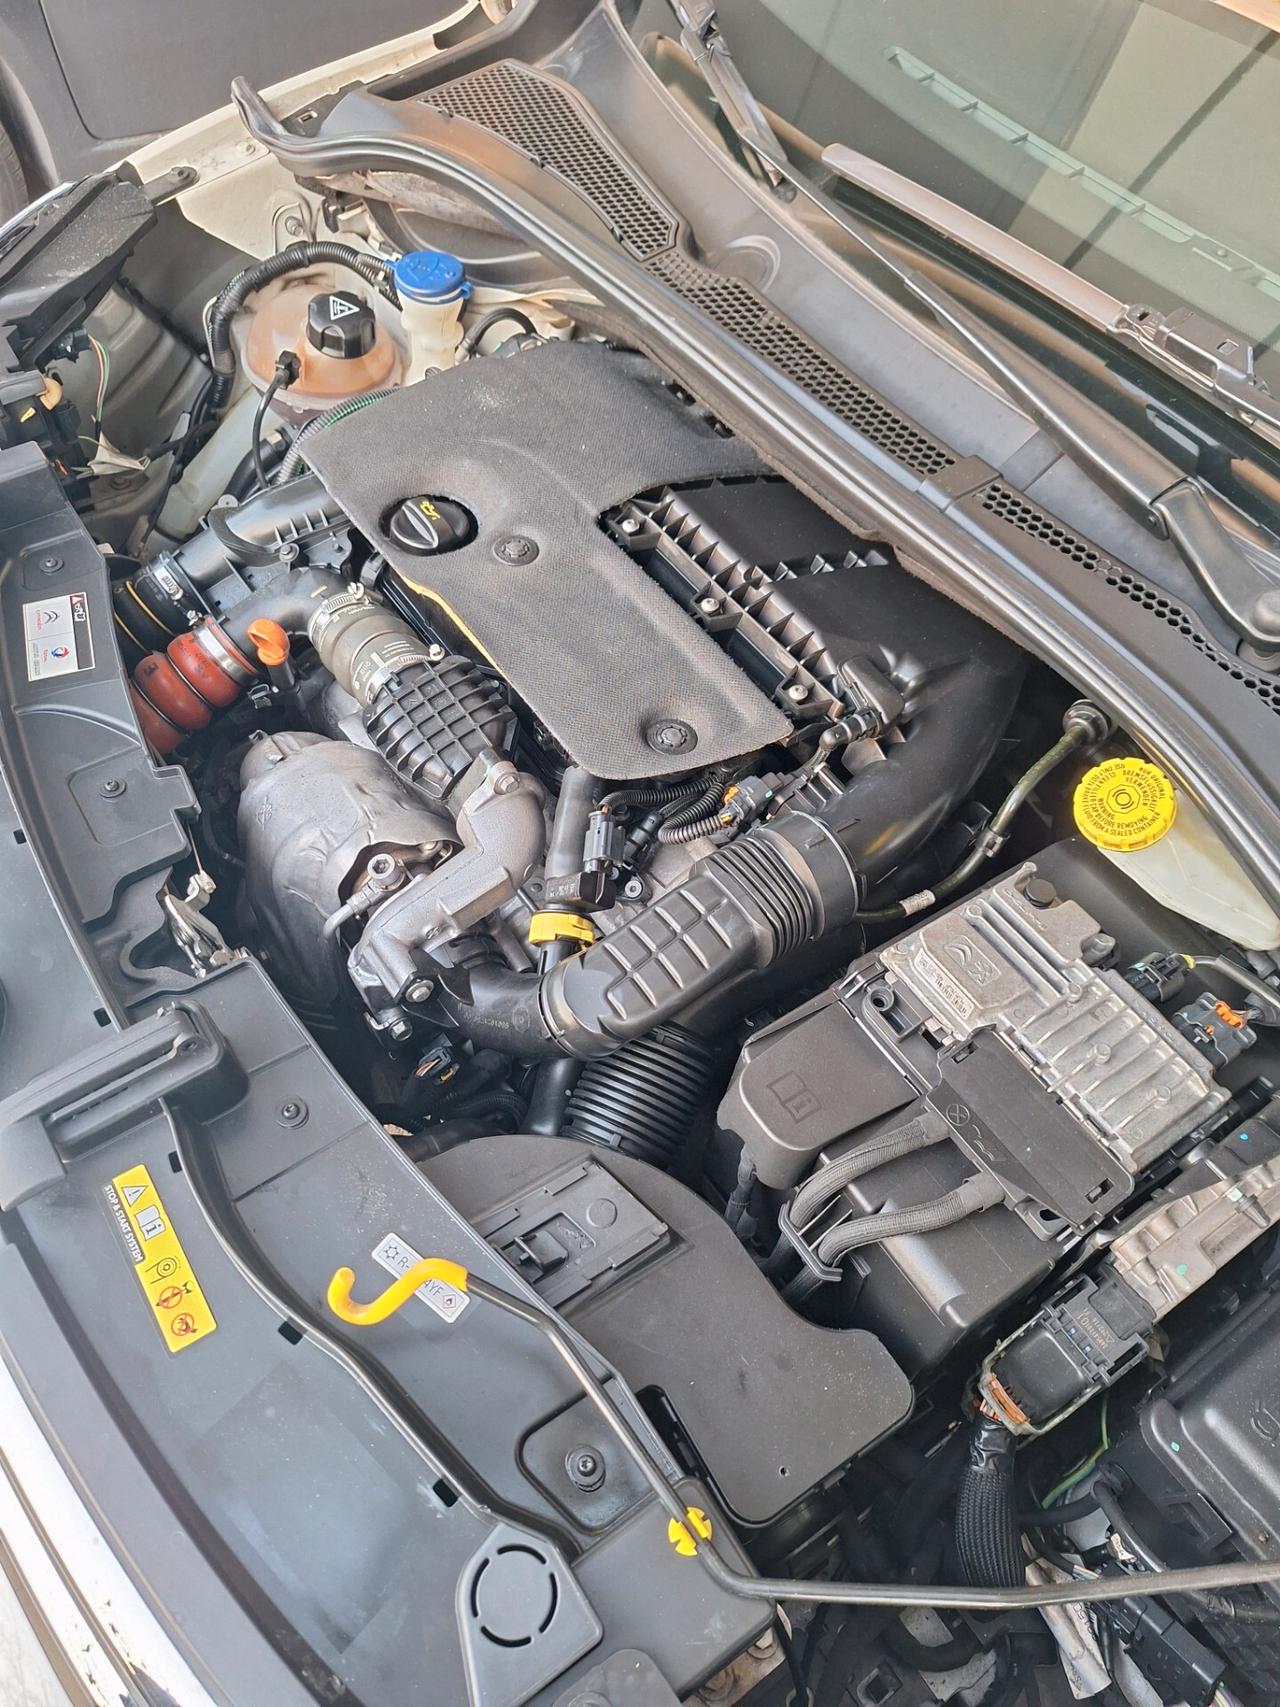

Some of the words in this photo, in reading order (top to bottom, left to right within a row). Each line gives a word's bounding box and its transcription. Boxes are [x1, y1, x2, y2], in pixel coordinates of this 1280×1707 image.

[1090, 803, 1099, 813] CAP
[1095, 812, 1116, 829] BEFORE
[1116, 814, 1149, 829] REMOVING
[1090, 817, 1106, 831] FROM
[1109, 828, 1133, 837] SEALED
[1132, 811, 1161, 834] CONTAINER
[104, 1184, 119, 1205] STOP
[112, 1204, 121, 1212] &
[115, 1209, 132, 1233] START
[124, 1232, 144, 1262] SYSTEM
